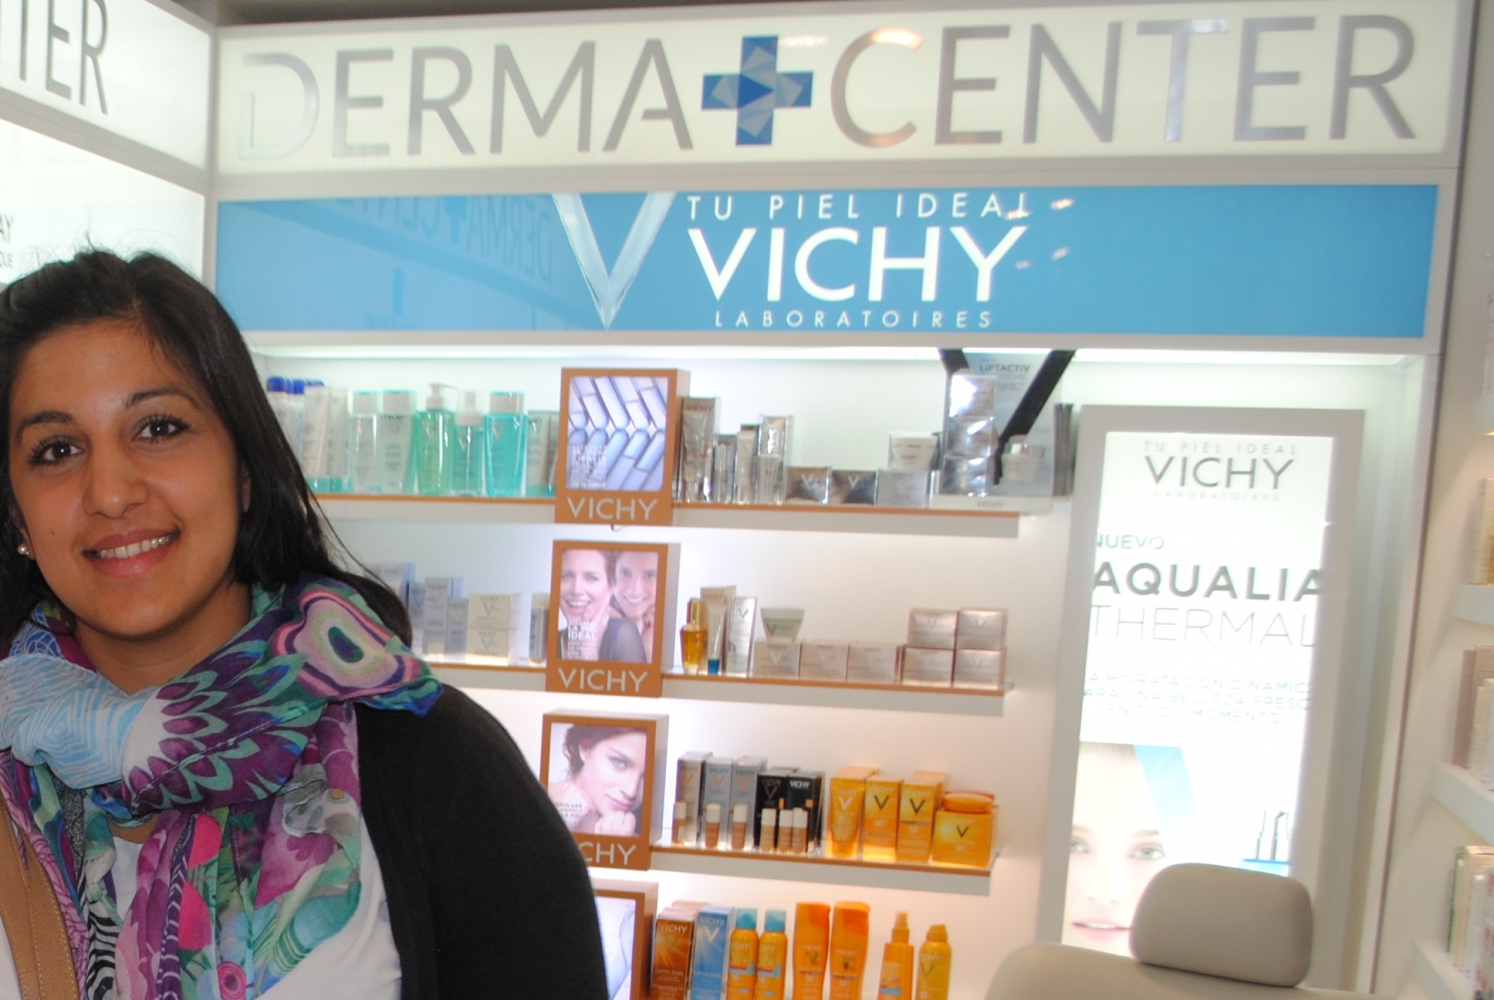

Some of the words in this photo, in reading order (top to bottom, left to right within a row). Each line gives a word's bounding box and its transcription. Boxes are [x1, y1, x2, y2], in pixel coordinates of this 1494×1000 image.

[239, 38, 694, 160] DERMA
[830, 14, 1417, 149] CENTER
[687, 195, 733, 220] TU
[769, 194, 861, 220] PIEL
[895, 192, 1030, 219] IDEAL
[687, 225, 1029, 302] VICHY
[715, 310, 992, 329] LABORATOIRES
[979, 364, 1031, 373] LIFTACTIV
[1144, 441, 1165, 452] TU
[1180, 442, 1222, 454] PIEL
[1237, 443, 1298, 456] IDEAL
[1144, 455, 1295, 490] VICHY
[1154, 491, 1280, 502] LABORATOIRES
[567, 497, 658, 520] VICHY
[1092, 561, 1323, 602] AQUALIA
[1091, 604, 1317, 648] THERMAL
[558, 667, 648, 693] VICHY
[789, 780, 811, 789] VICHY
[659, 923, 687, 934] VICHY
[700, 917, 725, 926] VICHY
